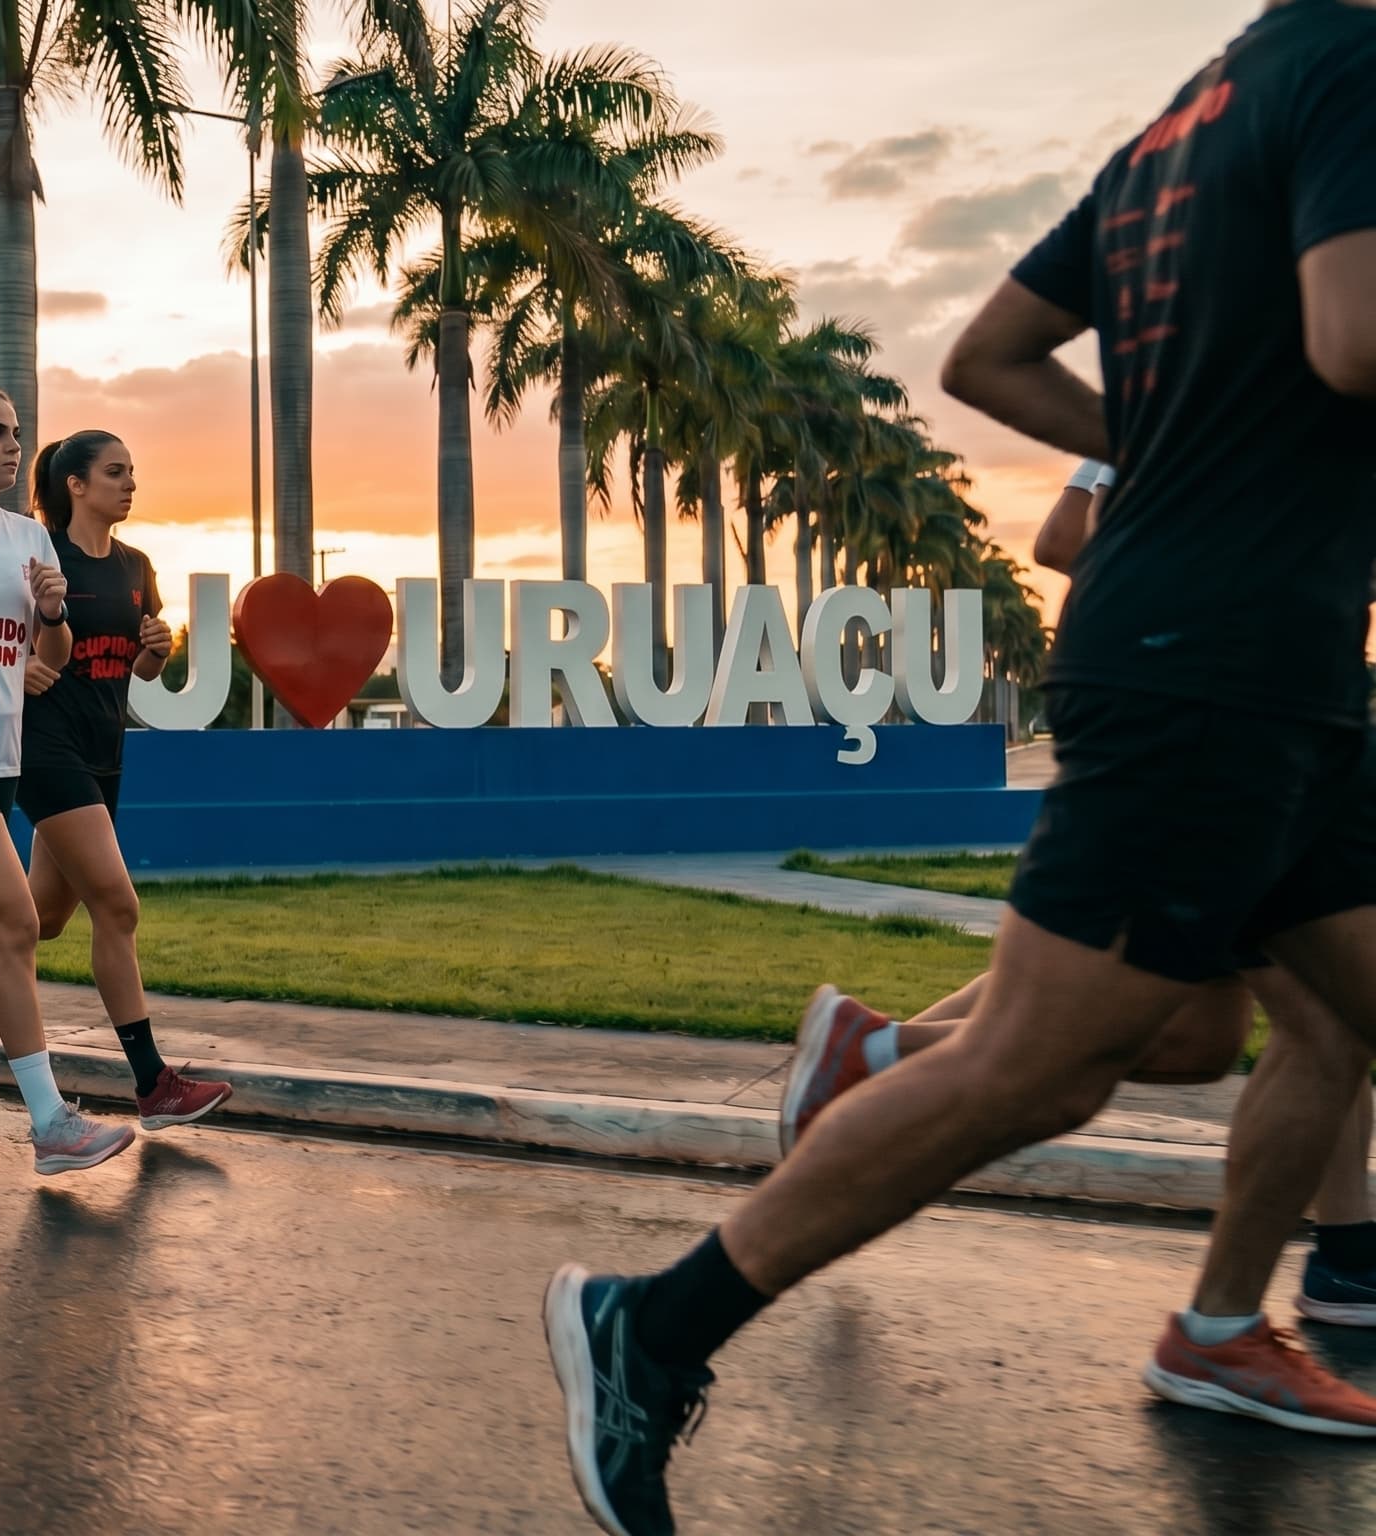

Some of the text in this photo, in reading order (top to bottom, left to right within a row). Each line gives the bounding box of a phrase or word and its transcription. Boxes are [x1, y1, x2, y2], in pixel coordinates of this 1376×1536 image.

[73, 635, 136, 660] CUPIDO
[91, 658, 126, 679] RUN
[396, 577, 984, 765] URUAÇU
